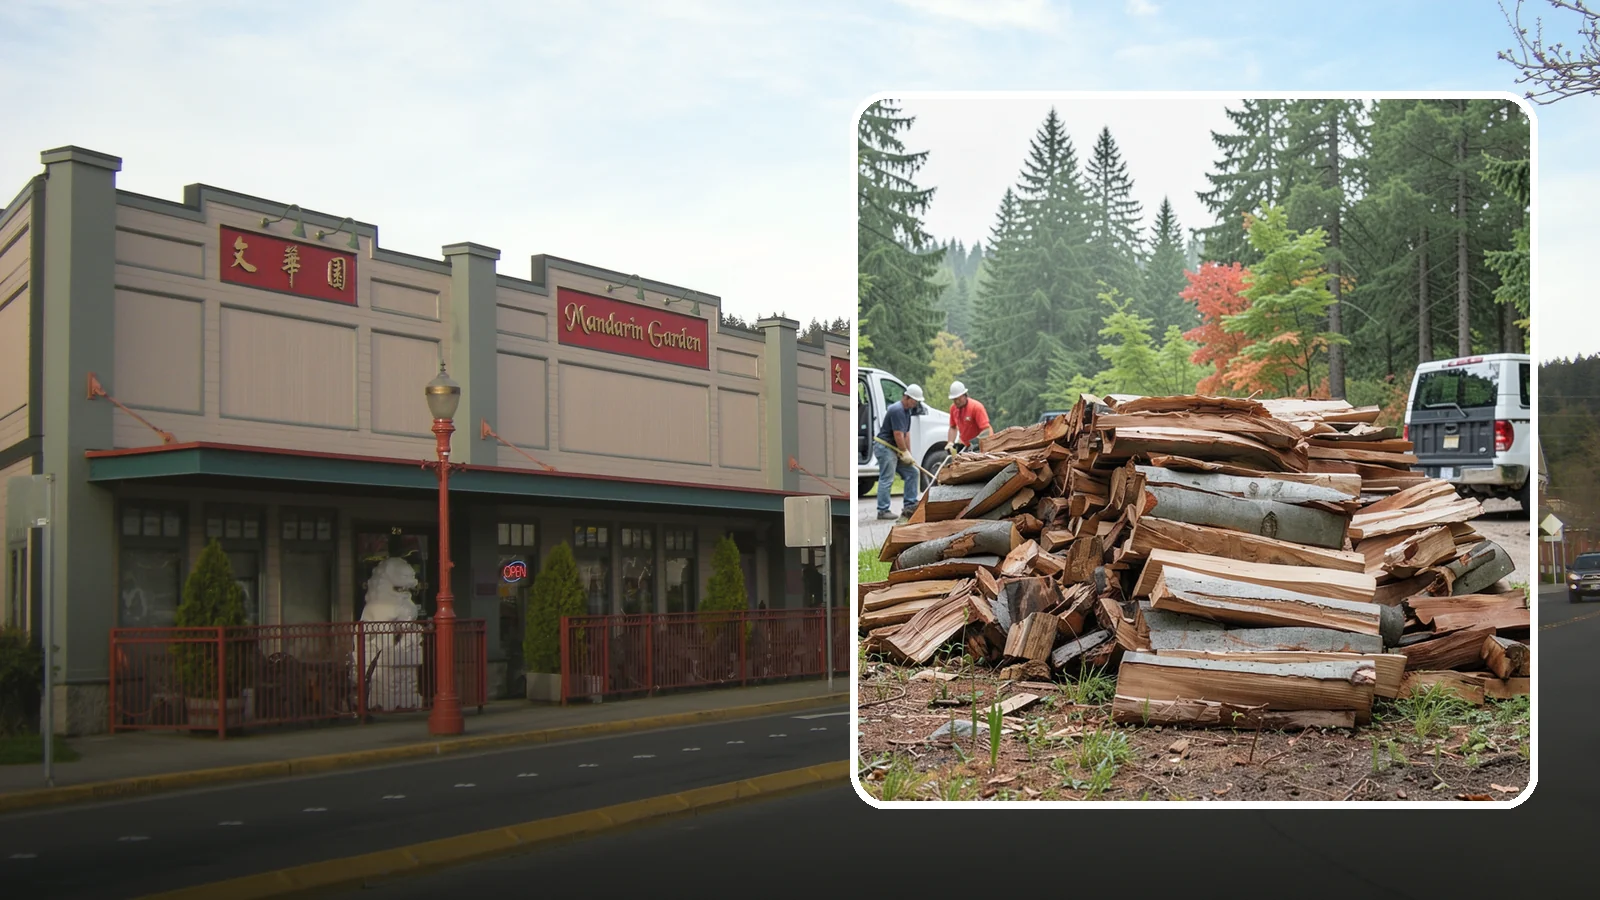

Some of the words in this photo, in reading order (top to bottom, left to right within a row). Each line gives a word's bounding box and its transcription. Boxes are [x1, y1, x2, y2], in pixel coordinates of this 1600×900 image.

[231, 236, 346, 291] 文華園
[565, 302, 643, 341] Mandarin
[648, 320, 701, 352] Garden
[503, 565, 527, 578] OPEN
